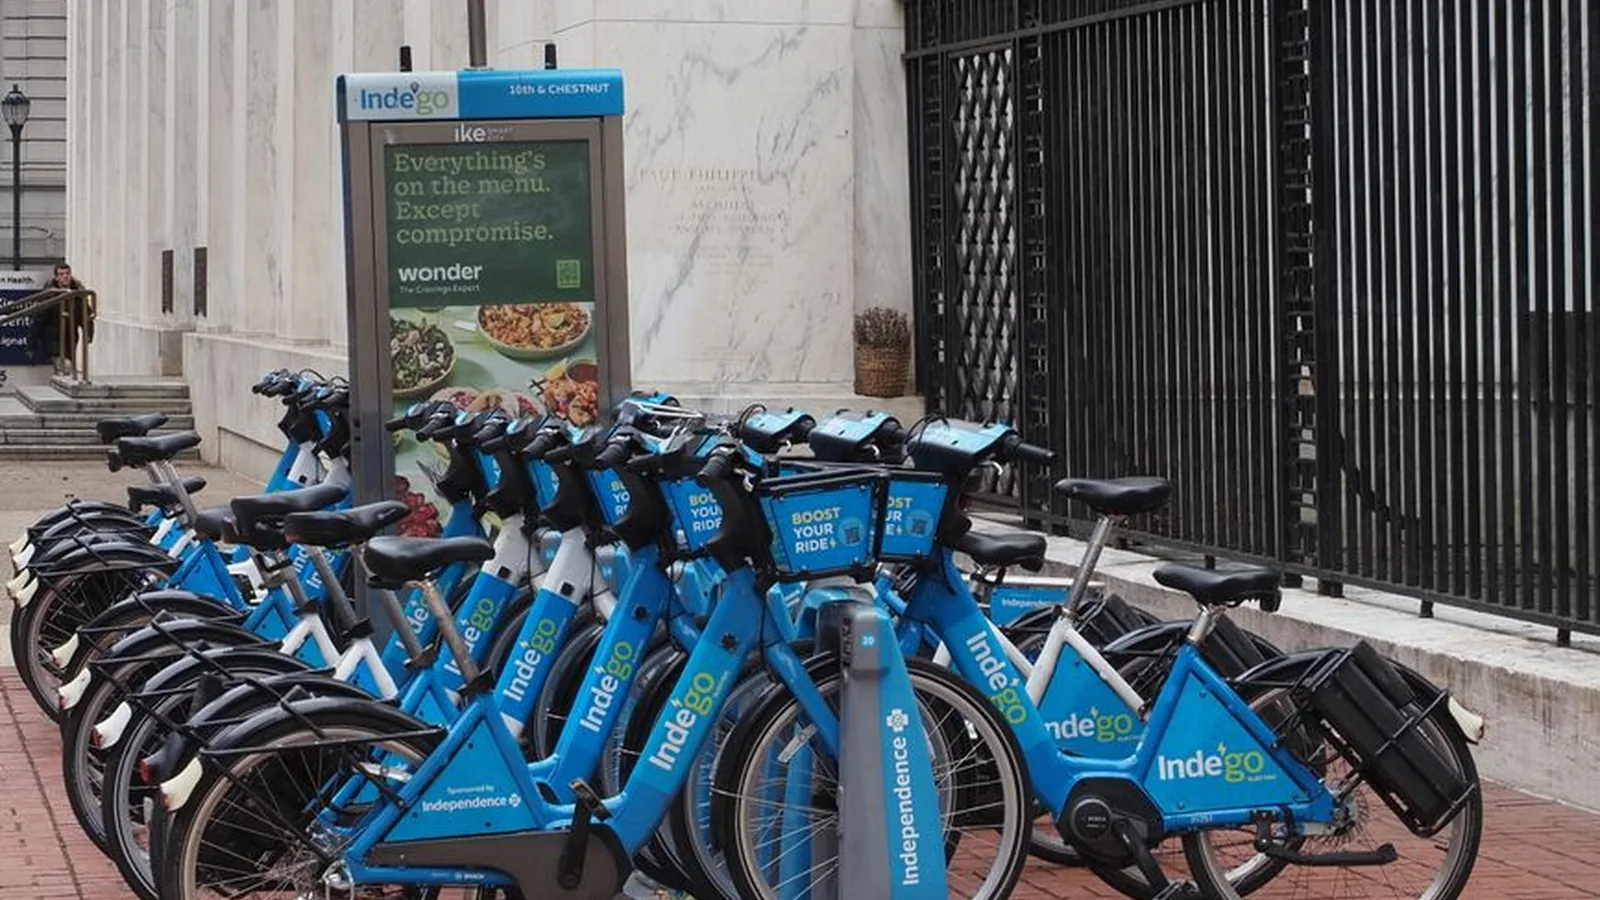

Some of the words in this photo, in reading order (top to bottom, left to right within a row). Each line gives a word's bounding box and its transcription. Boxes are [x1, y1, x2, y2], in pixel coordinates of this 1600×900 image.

[509, 84, 535, 95] 10th
[537, 84, 546, 95] &
[548, 83, 610, 95] CHESTNUT
[454, 123, 486, 142] ike
[394, 150, 546, 175] Everything's
[394, 180, 424, 196] on
[432, 175, 471, 195] the
[478, 177, 550, 195] menu.
[395, 201, 481, 223] Except
[396, 220, 554, 247] compromise.
[398, 262, 483, 282] wonder
[400, 285, 414, 294] The
[792, 506, 841, 525] BOOST
[793, 523, 833, 539] YOUR
[795, 537, 830, 553] RIDE
[1045, 711, 1132, 743] ndego
[421, 796, 507, 813] Independence
[892, 736, 921, 886] Independence
